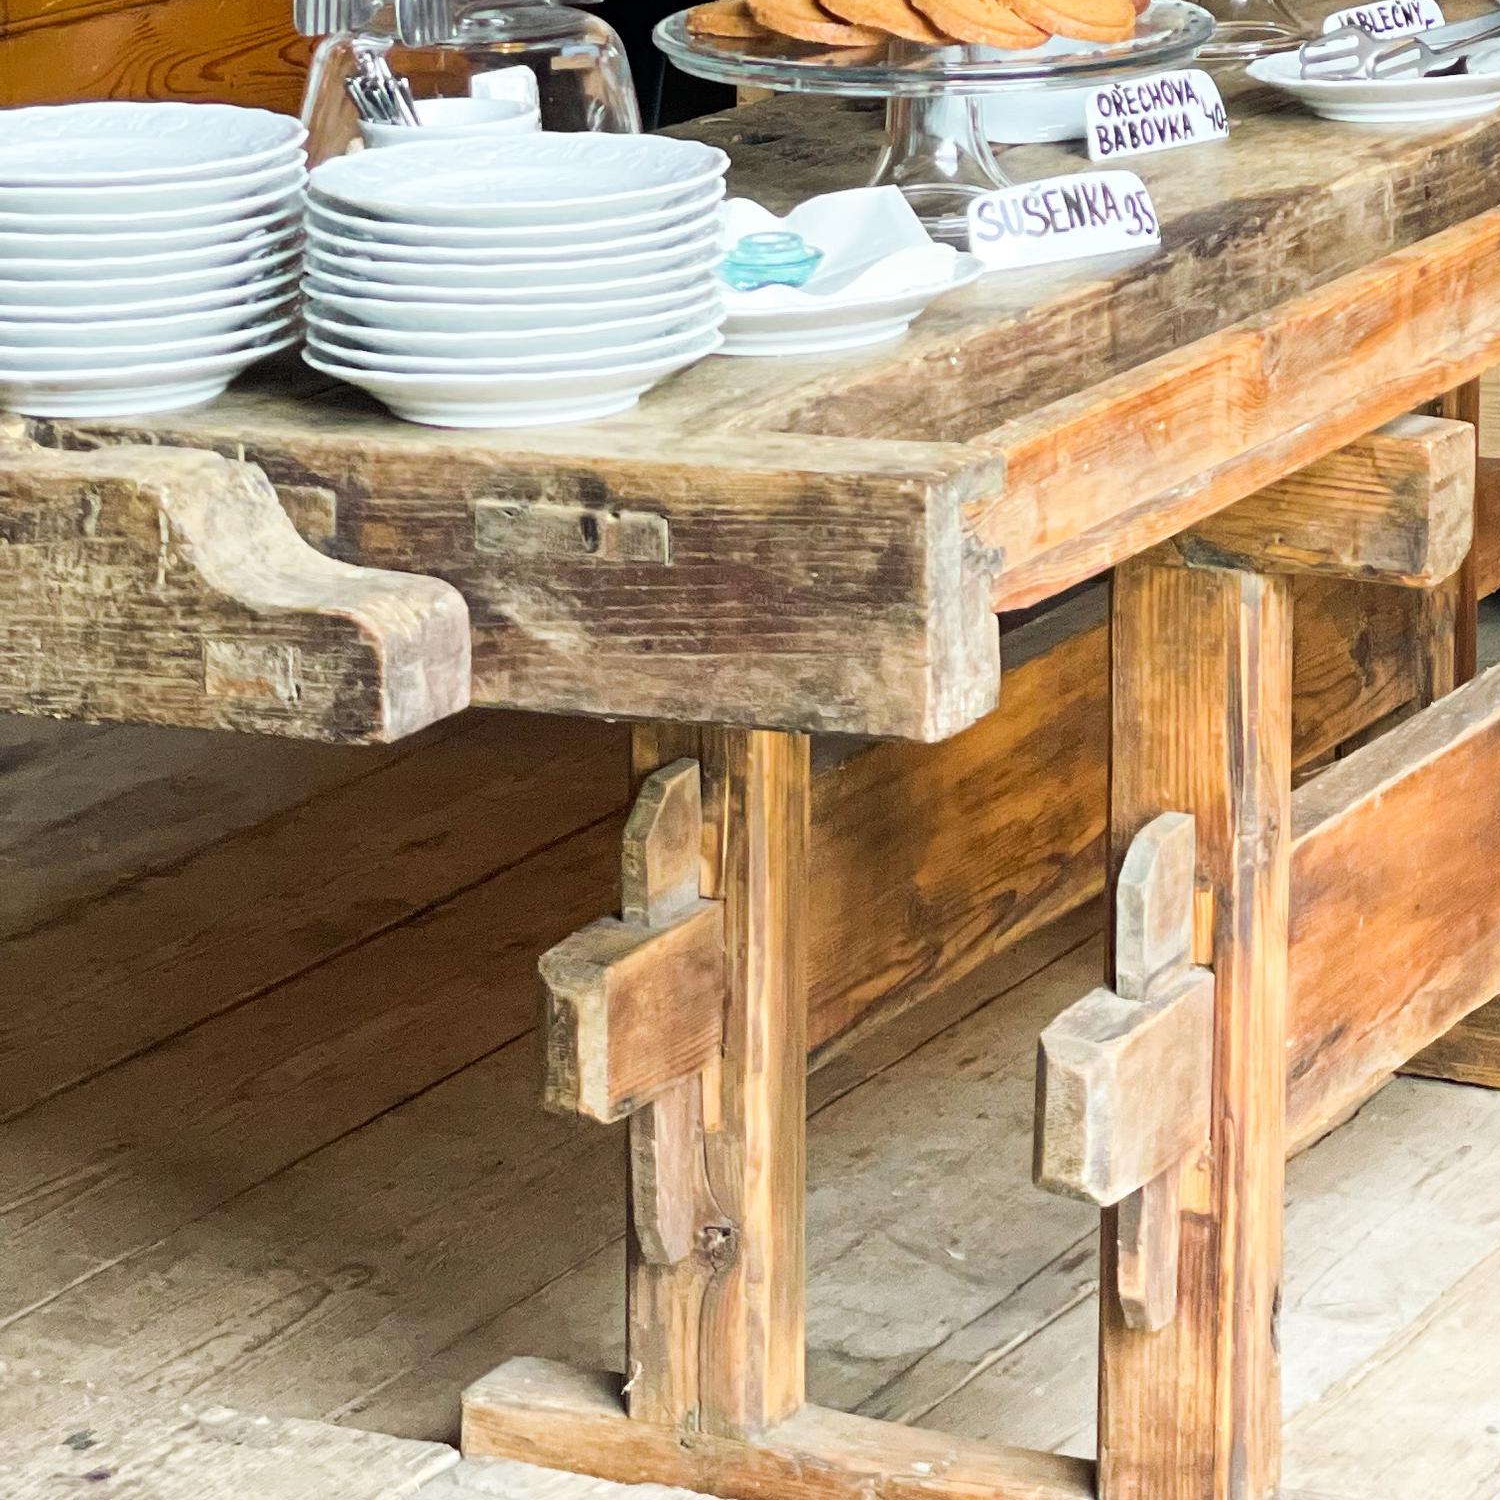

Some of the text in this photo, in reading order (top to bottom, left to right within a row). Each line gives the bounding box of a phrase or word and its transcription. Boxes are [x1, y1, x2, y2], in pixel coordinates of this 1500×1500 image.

[1097, 72, 1199, 119] OŘECHOVÁ
[1095, 113, 1195, 155] BÁBOVKA
[976, 181, 1122, 242] SUŠENKA
